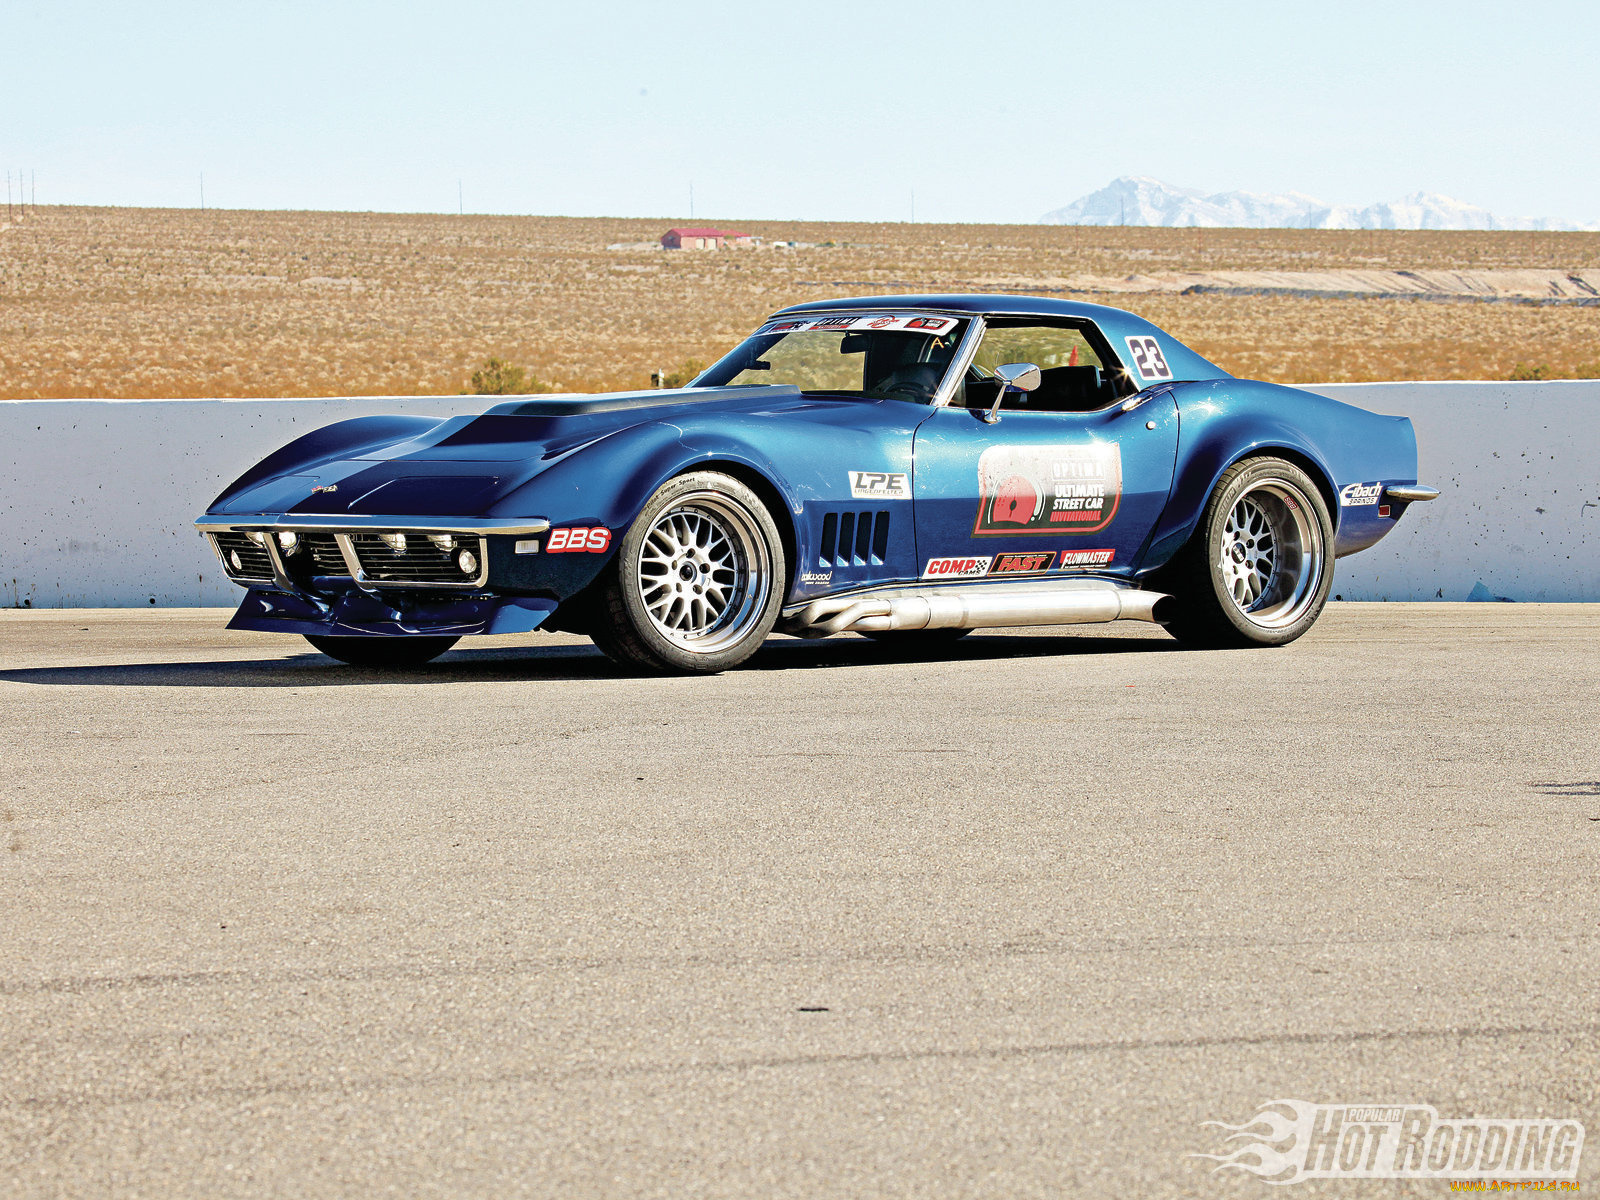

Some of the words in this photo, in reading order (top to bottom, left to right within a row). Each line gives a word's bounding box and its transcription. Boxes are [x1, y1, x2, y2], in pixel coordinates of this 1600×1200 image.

[1129, 338, 1170, 378] 23
[678, 477, 696, 486] Sport
[855, 473, 905, 489] LPE
[1054, 484, 1105, 498] ULTIMATE
[1340, 482, 1383, 499] Eibach
[1052, 498, 1086, 510] STREET
[1085, 497, 1104, 509] CAR
[547, 528, 609, 549] BBS
[928, 559, 976, 574] COMP
[998, 557, 1047, 571] FAST
